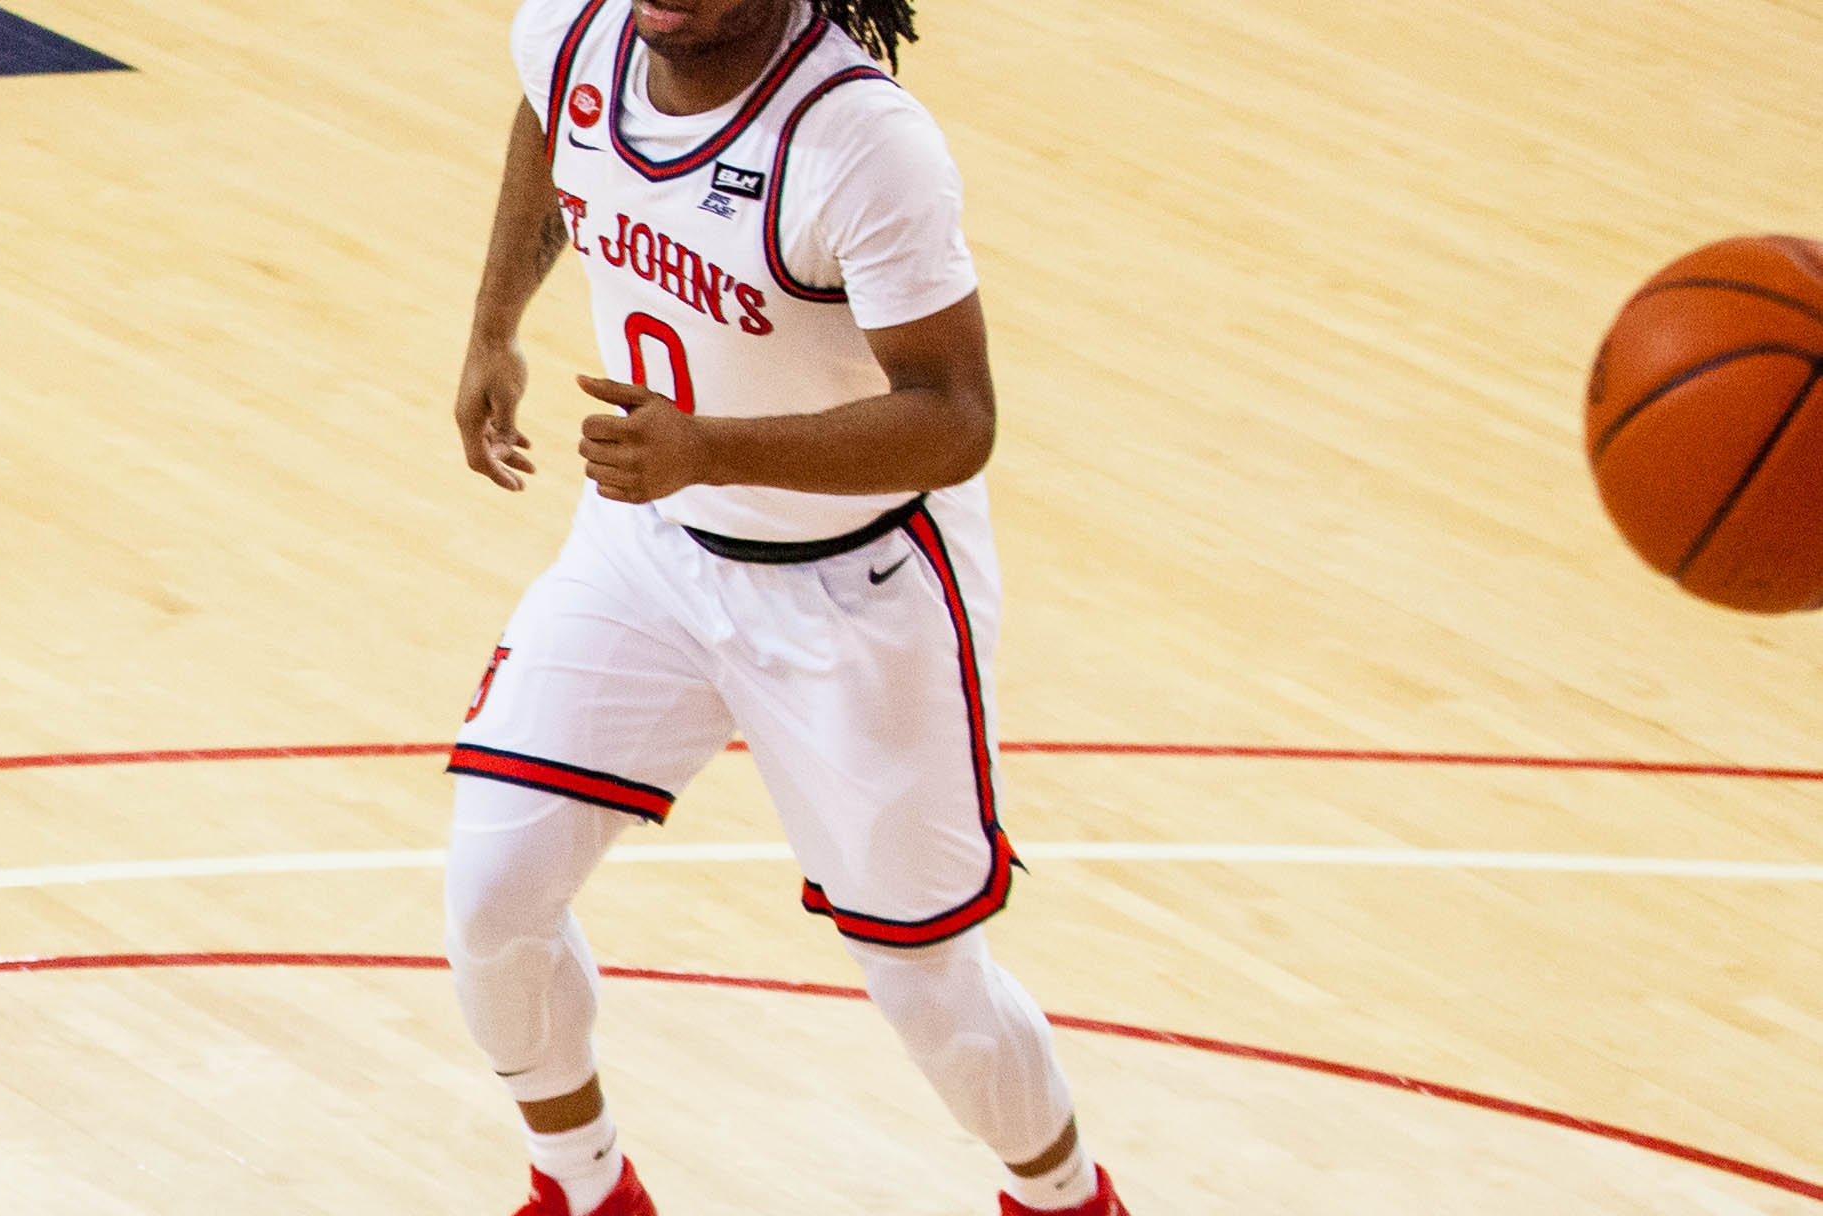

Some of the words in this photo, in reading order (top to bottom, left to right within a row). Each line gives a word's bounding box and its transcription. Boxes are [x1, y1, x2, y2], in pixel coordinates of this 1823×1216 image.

[717, 168, 761, 190] BLM
[598, 213, 774, 336] JOHN'S
[624, 311, 695, 415] 0
